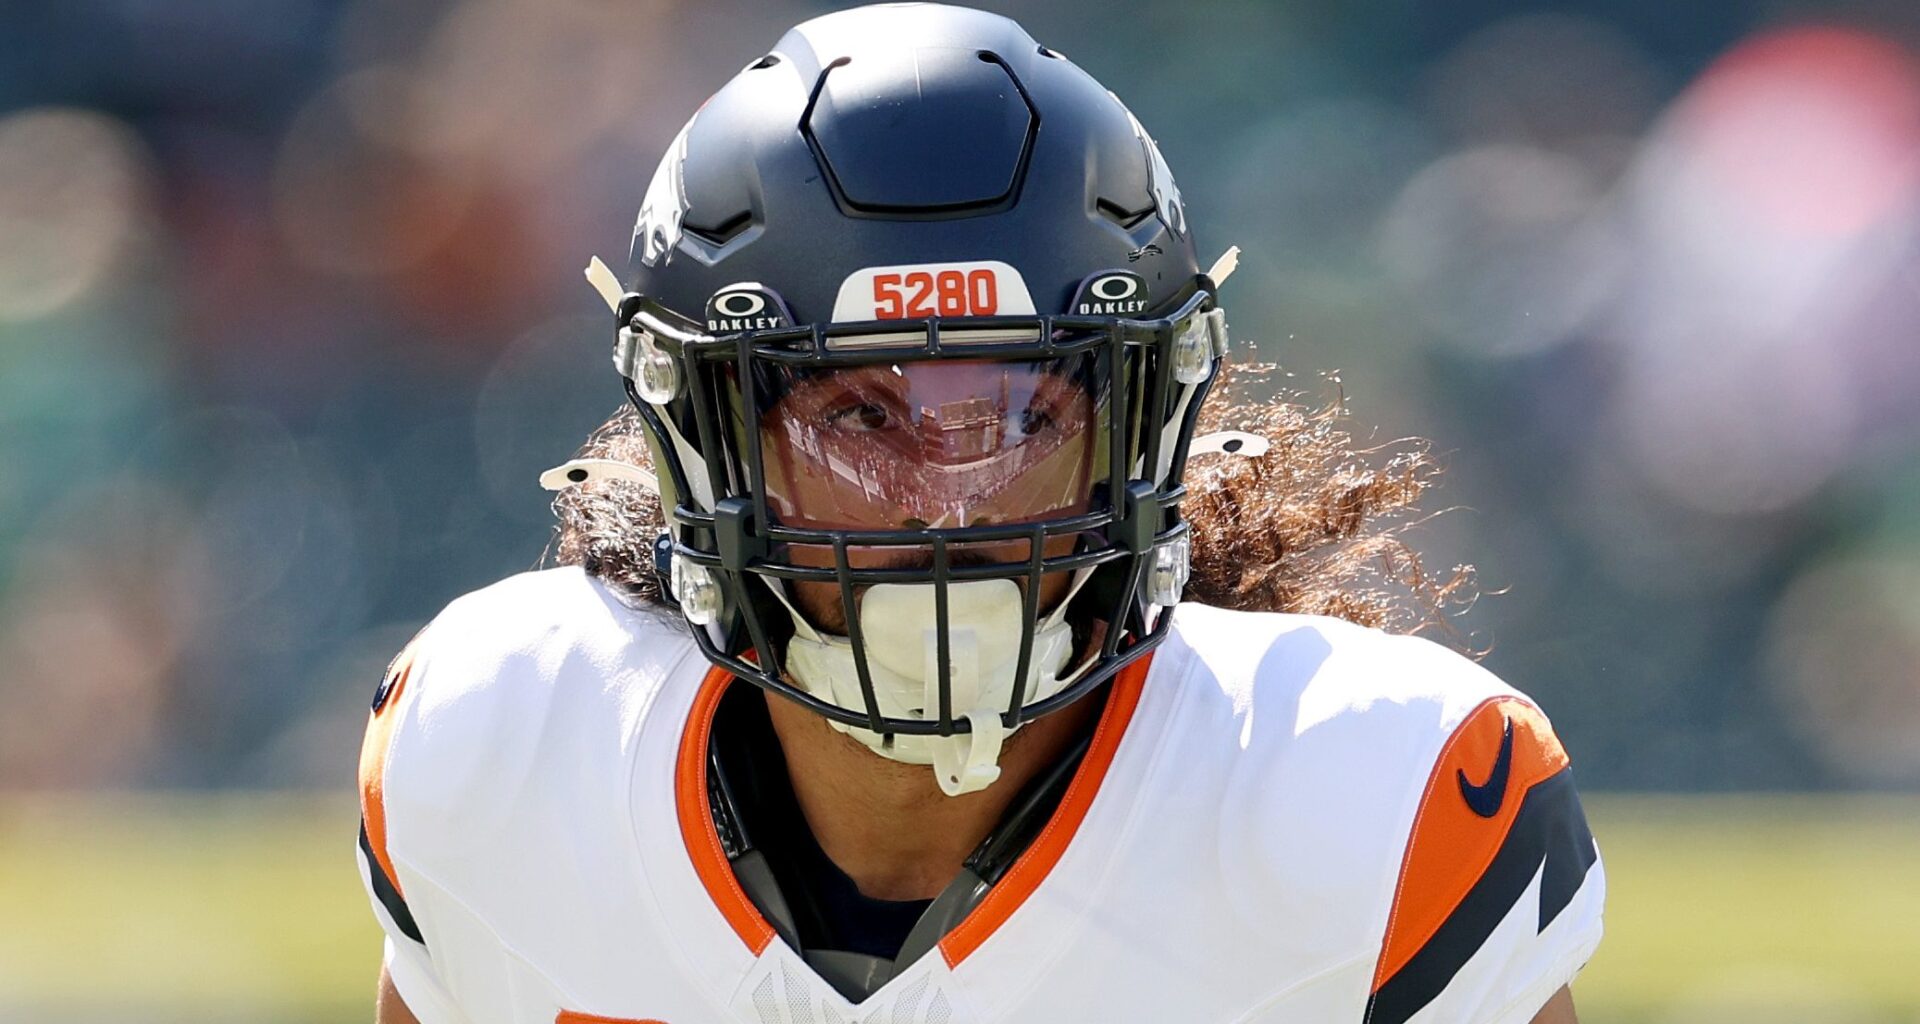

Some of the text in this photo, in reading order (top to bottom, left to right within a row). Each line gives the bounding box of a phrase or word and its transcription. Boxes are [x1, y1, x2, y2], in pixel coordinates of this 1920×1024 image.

[873, 269, 998, 320] 5280
[1080, 301, 1145, 315] OAKLEY
[708, 317, 779, 331] OAKLEY
